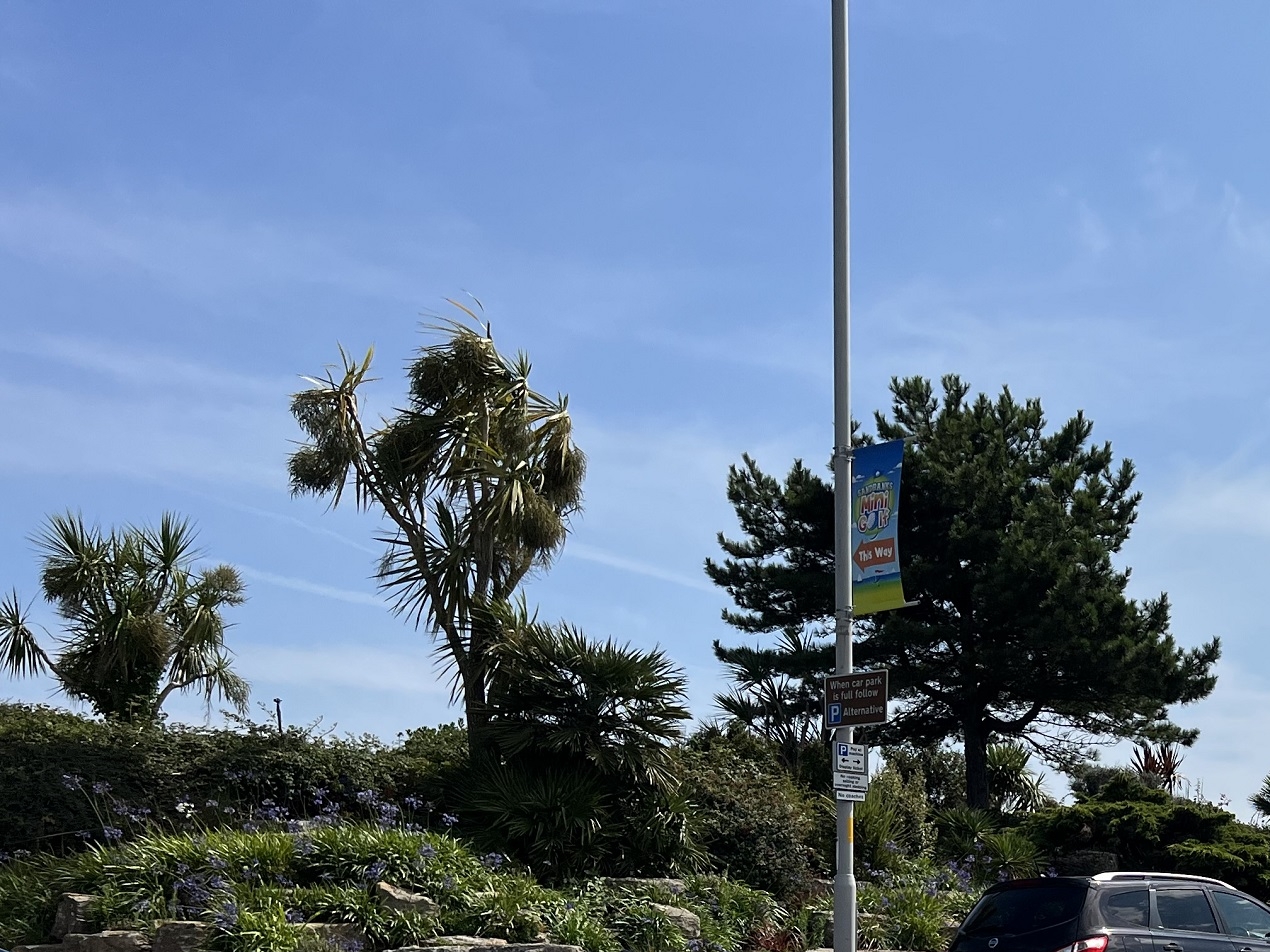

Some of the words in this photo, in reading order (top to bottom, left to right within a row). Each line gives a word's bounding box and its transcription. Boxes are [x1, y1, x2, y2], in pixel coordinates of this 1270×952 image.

[857, 482, 894, 497] SANDBANKS
[859, 549, 873, 562] This
[875, 545, 893, 560] Way
[830, 680, 850, 690] When
[852, 679, 863, 688] car
[865, 676, 883, 688] park
[833, 691, 839, 701] is
[841, 689, 853, 700] full
[855, 688, 879, 699] follow
[831, 705, 840, 722] P
[843, 704, 884, 717] Alternative
